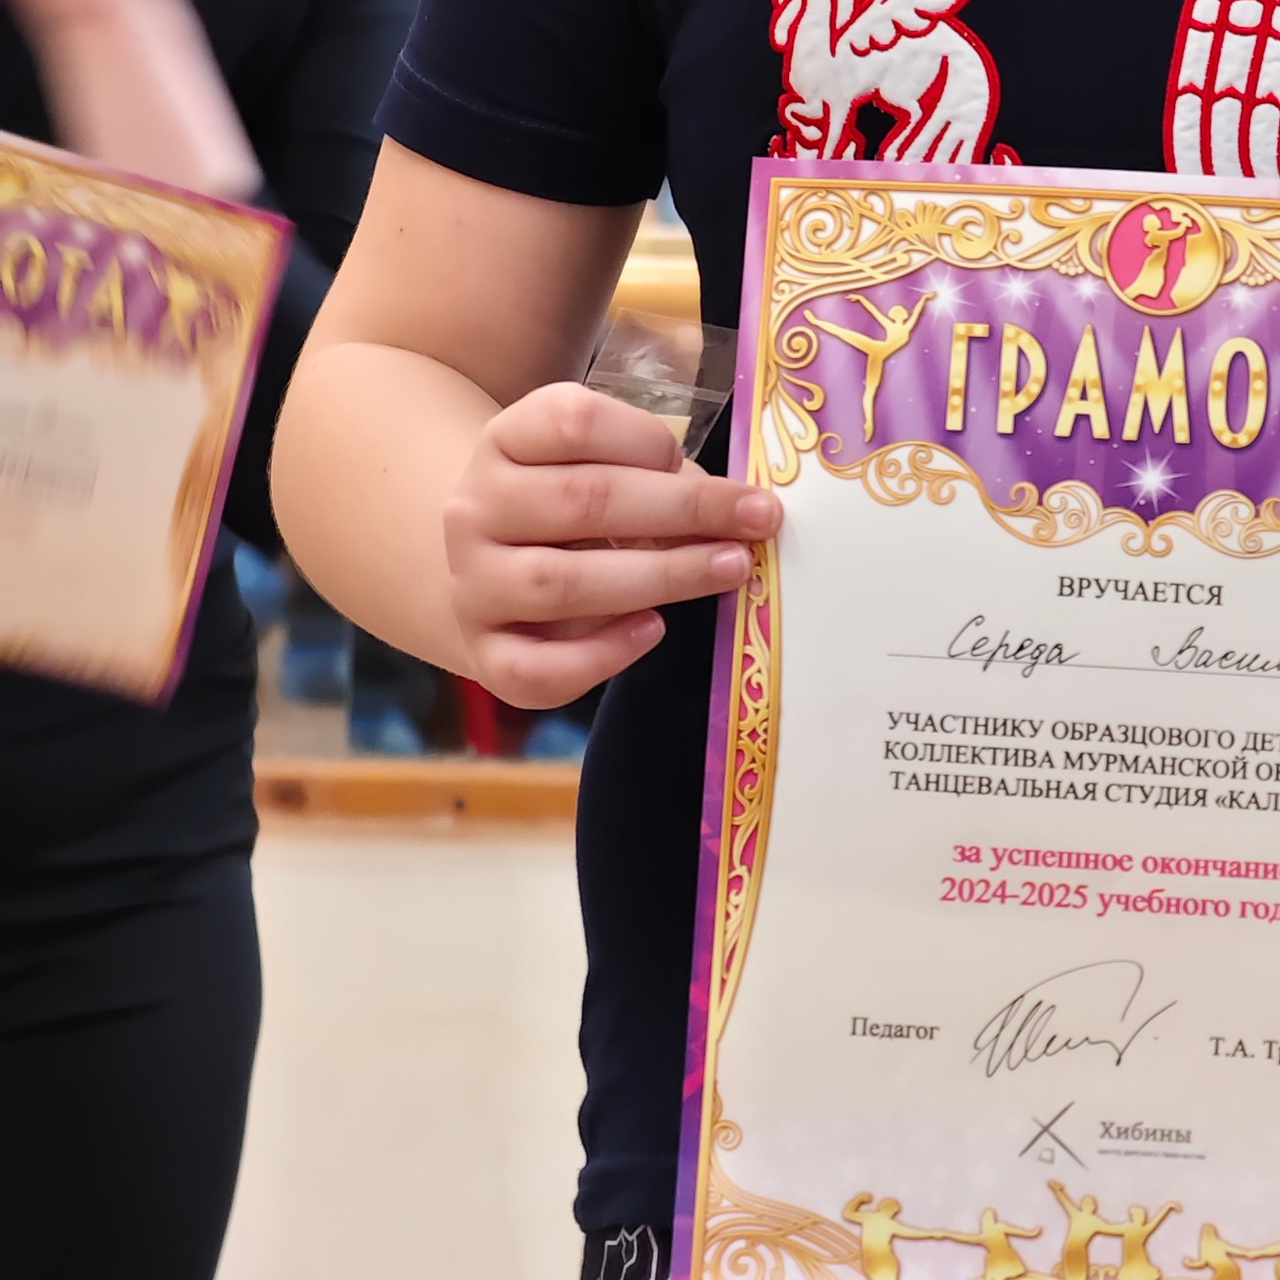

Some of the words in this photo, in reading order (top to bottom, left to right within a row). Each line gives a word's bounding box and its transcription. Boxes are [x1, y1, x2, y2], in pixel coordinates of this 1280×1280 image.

[1057, 576, 1223, 606] ВРУЧАЕТСЯ
[947, 614, 1081, 678] Середа
[887, 711, 1044, 738] УЧАСТНИКУ
[1051, 721, 1235, 749] ОБРАЗЦОВОГО
[884, 740, 1056, 769] КОЛЛЕКТИВА
[1063, 751, 1249, 780] МУРМАНСКОЙ
[890, 771, 1098, 801] ТАНЦЕВАЛЬНАЯ
[1105, 783, 1208, 809] СТУДИЯ
[953, 845, 982, 864] за
[989, 847, 1133, 872] успешное
[940, 876, 1088, 909] 2024-2025
[1096, 888, 1231, 917] учебного
[851, 1017, 940, 1041] Педагог
[1210, 1037, 1255, 1059] Т.А.
[1100, 1121, 1192, 1144] Хибины
